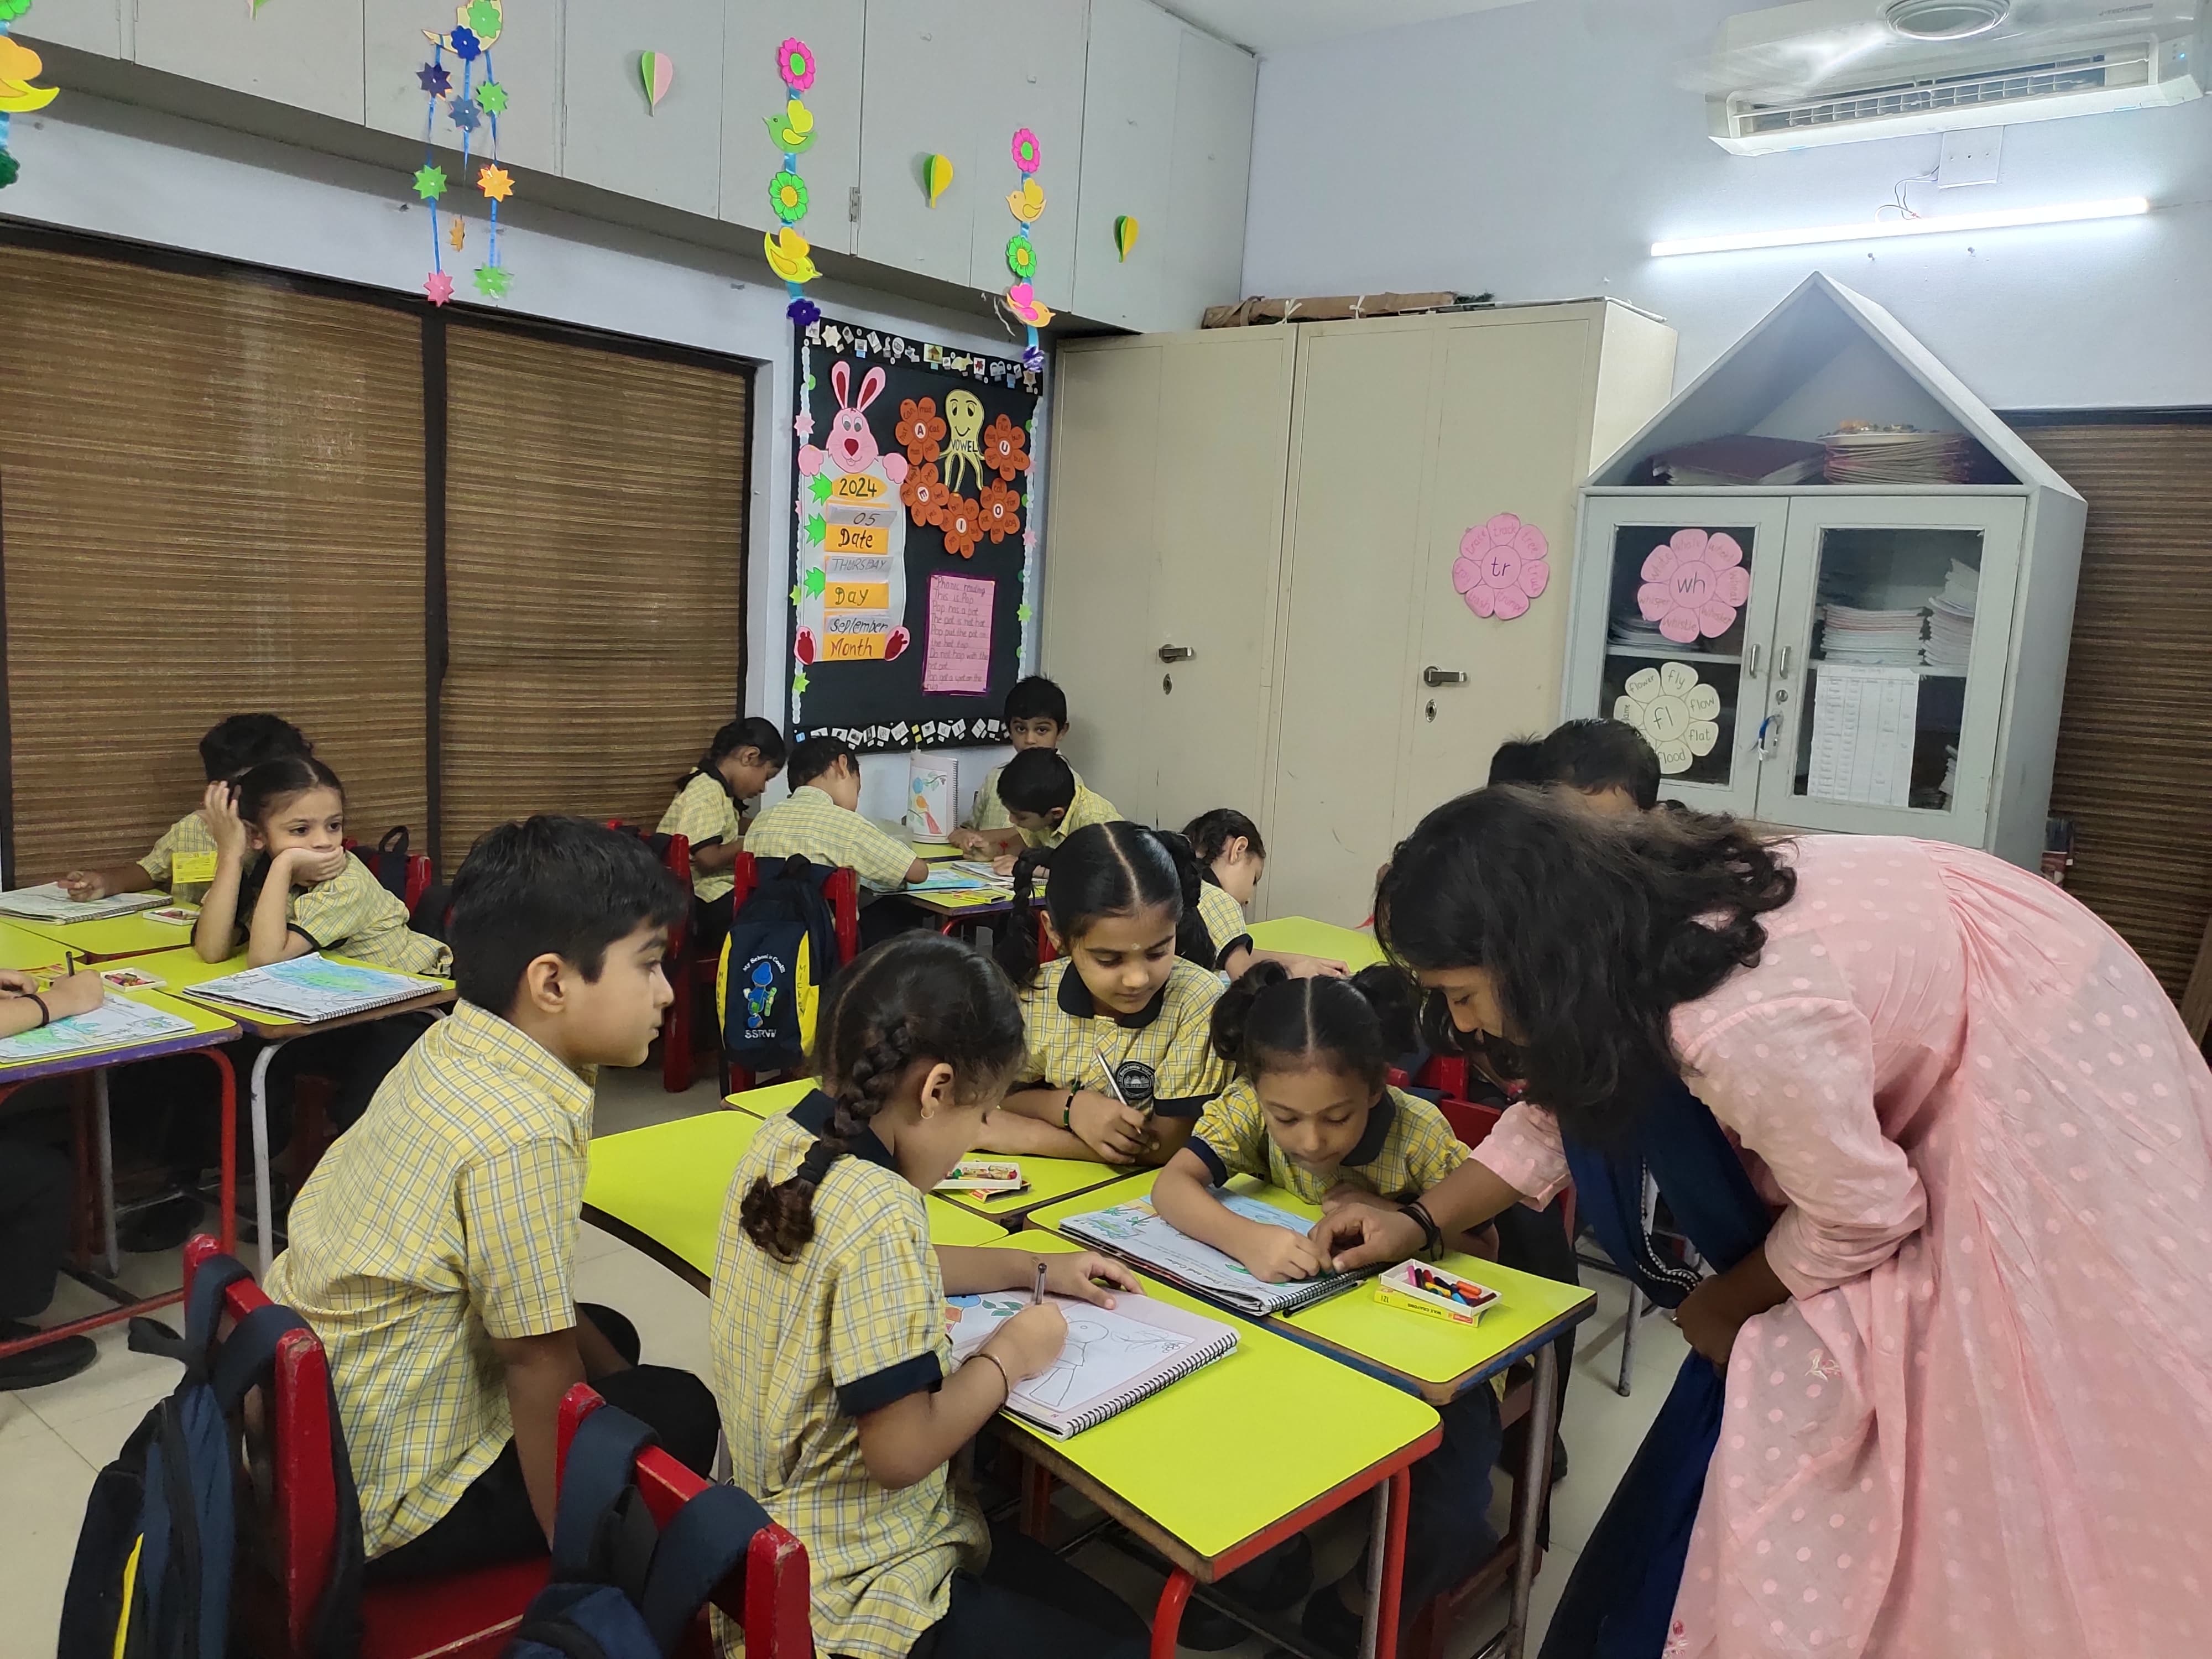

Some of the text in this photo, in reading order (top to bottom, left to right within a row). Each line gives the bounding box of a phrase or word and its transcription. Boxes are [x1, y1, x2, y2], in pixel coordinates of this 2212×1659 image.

[917, 425, 924, 435] A
[951, 439, 978, 452] VOWEL
[1002, 442, 1008, 452] U
[839, 477, 877, 497] 2024
[919, 489, 927, 499] E
[995, 505, 1001, 515] O
[853, 512, 880, 526] 05
[838, 528, 873, 549] Date
[1491, 556, 1511, 577] tr
[1678, 571, 1705, 594] wh
[835, 586, 869, 606] Day
[933, 588, 948, 601] This
[1663, 617, 1697, 632] whistle
[831, 637, 872, 658] Month
[1629, 675, 1655, 693] flower
[1667, 669, 1686, 690] fly
[1621, 704, 1631, 721] lame
[1690, 697, 1715, 712] flow
[1653, 706, 1673, 730] fl
[1688, 728, 1711, 742] flat
[1658, 747, 1686, 764] flood
